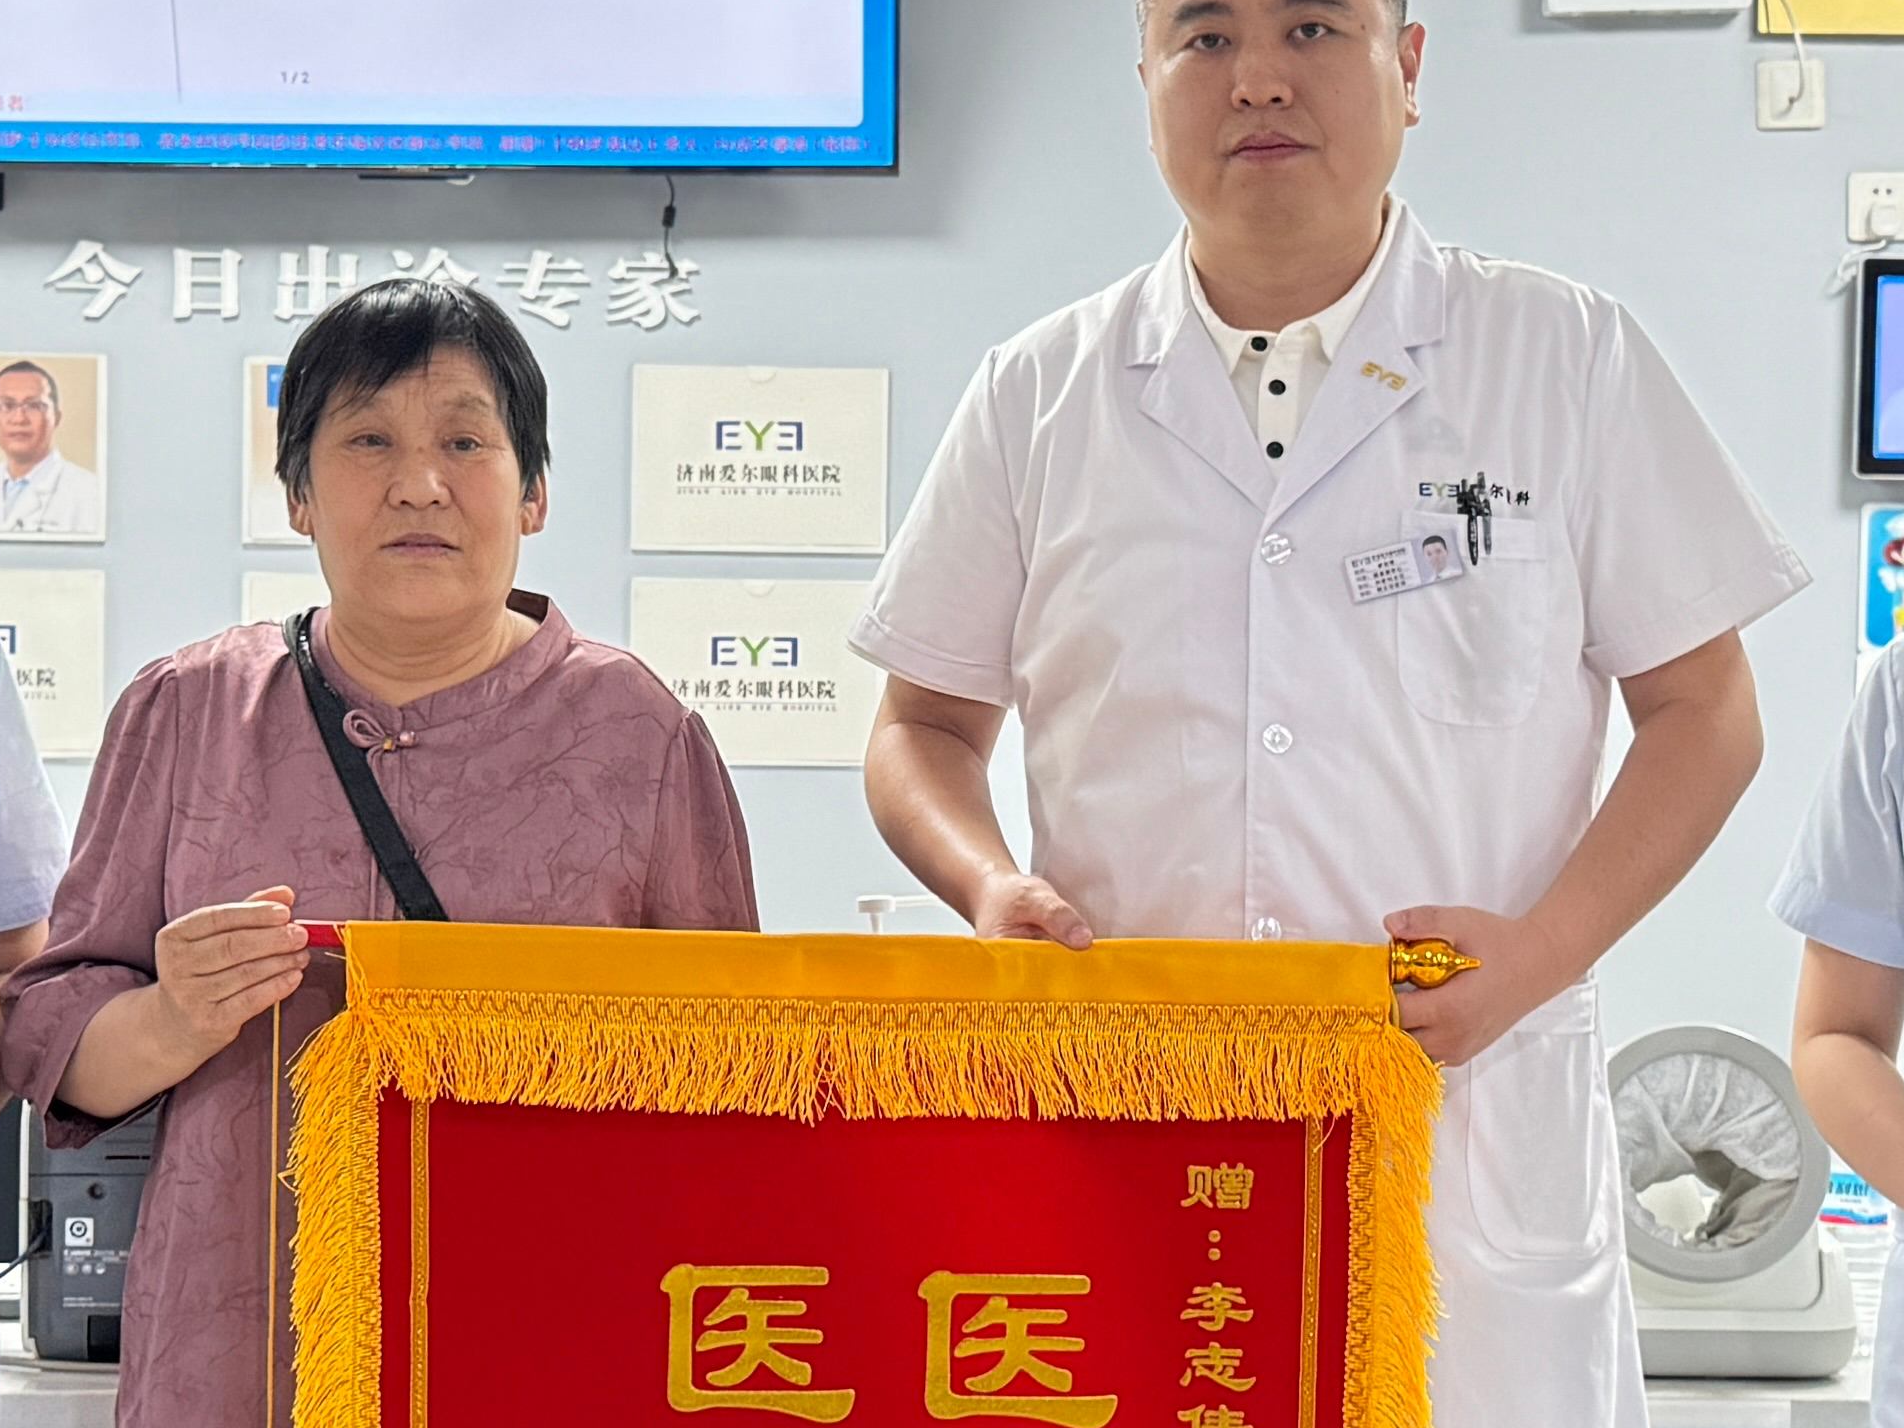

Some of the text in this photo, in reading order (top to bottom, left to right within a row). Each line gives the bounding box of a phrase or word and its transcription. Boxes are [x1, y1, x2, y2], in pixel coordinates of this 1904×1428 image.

[716, 421, 803, 451] EYE
[676, 464, 841, 485] 济南爱尔眼科医院
[711, 637, 798, 666] EYE
[672, 679, 836, 700] 济南爱尔眼科医院
